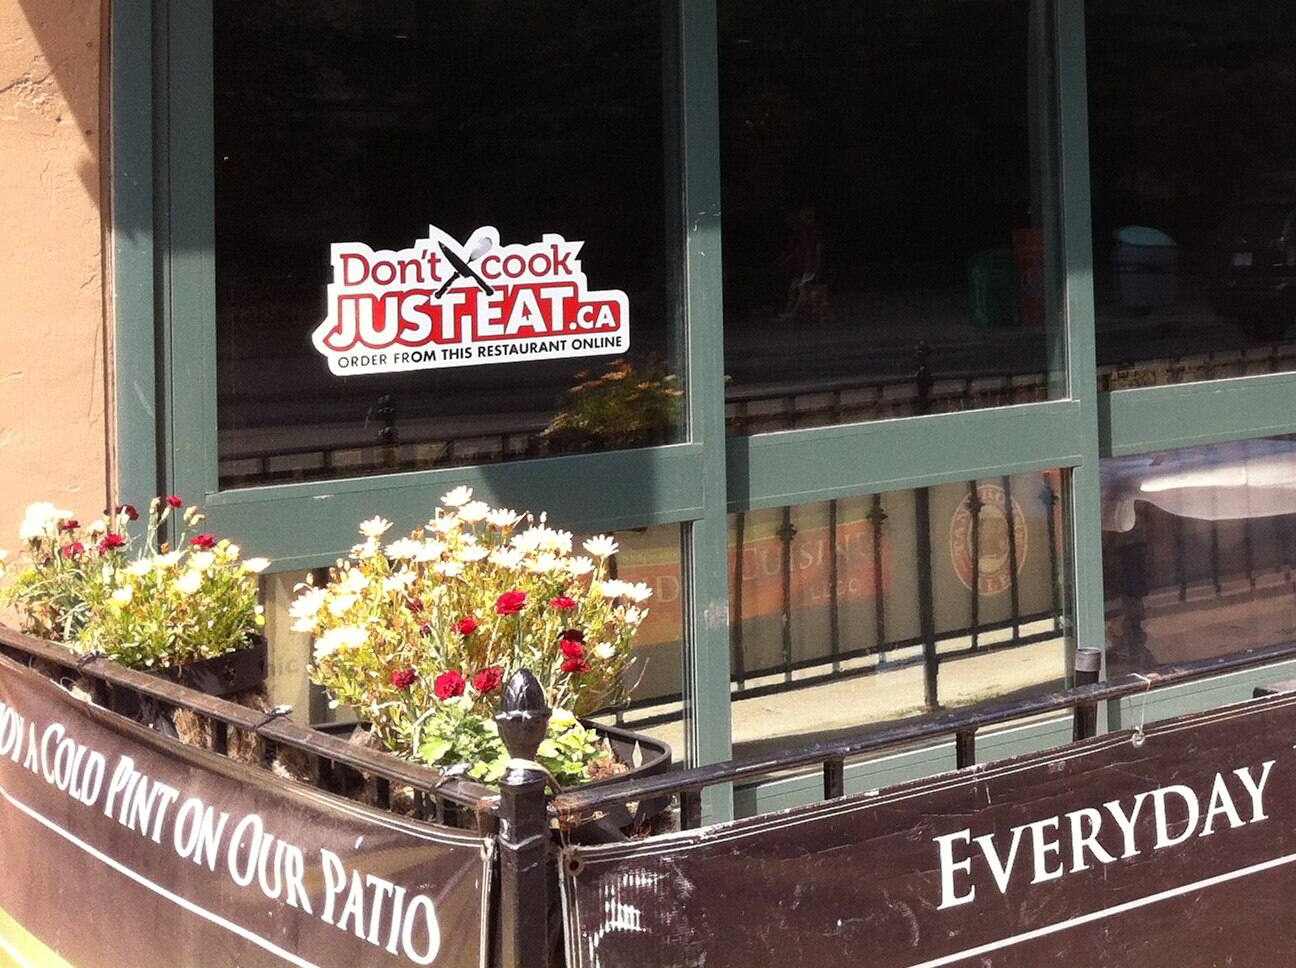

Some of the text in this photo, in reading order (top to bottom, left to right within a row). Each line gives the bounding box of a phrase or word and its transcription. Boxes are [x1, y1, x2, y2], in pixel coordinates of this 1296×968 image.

[480, 244, 573, 280] cook
[338, 335, 622, 368] ORDER FROM THIS RESTAURANT ONLINE
[24, 722, 39, 774] A
[41, 722, 106, 807] COLD
[104, 754, 179, 844] PINT
[173, 797, 230, 872] ON
[226, 813, 313, 915] OUR
[319, 847, 442, 966] PATIO
[931, 759, 1277, 911] EVERYDAY
